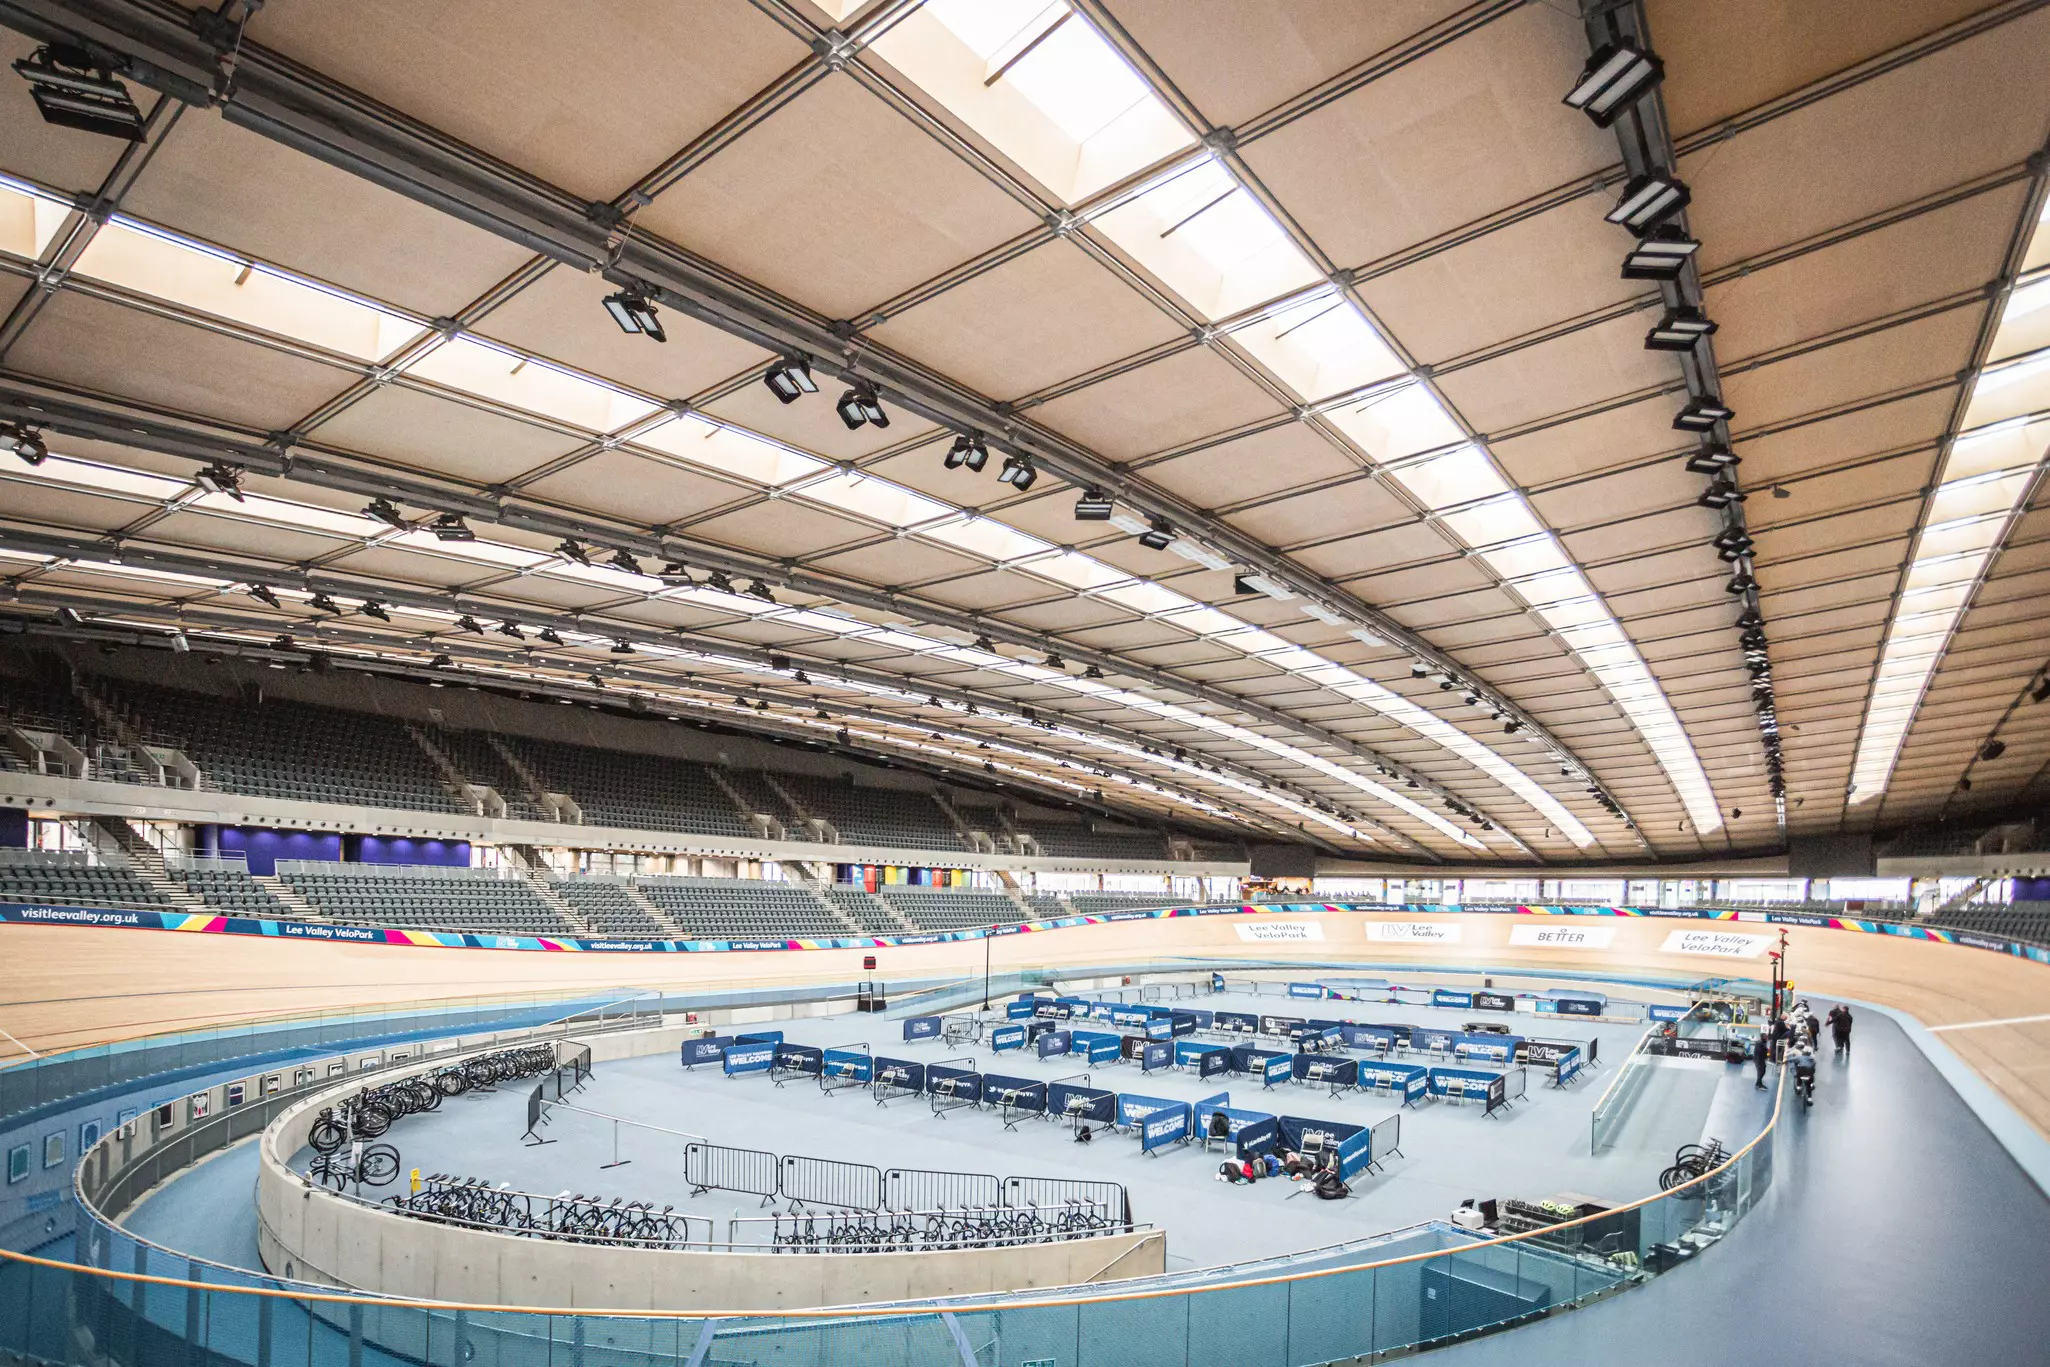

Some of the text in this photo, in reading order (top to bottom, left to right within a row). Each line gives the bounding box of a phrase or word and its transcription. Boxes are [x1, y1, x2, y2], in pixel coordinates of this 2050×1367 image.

[21, 908, 139, 924] visitleevalley.org.uk
[286, 925, 374, 940] Lee Valley VeloPark
[1412, 930, 1445, 939] Valley
[1537, 932, 1585, 943] BETTER
[1685, 934, 1755, 945] Lee Valley
[590, 942, 653, 951] visitleevalley.org.uk
[1681, 943, 1743, 955] VeloPark
[1528, 1045, 1546, 1058] LV
[730, 1054, 773, 1066] WELCOME
[1148, 1119, 1185, 1139] WELCOME
[1325, 1139, 1342, 1147] alley
